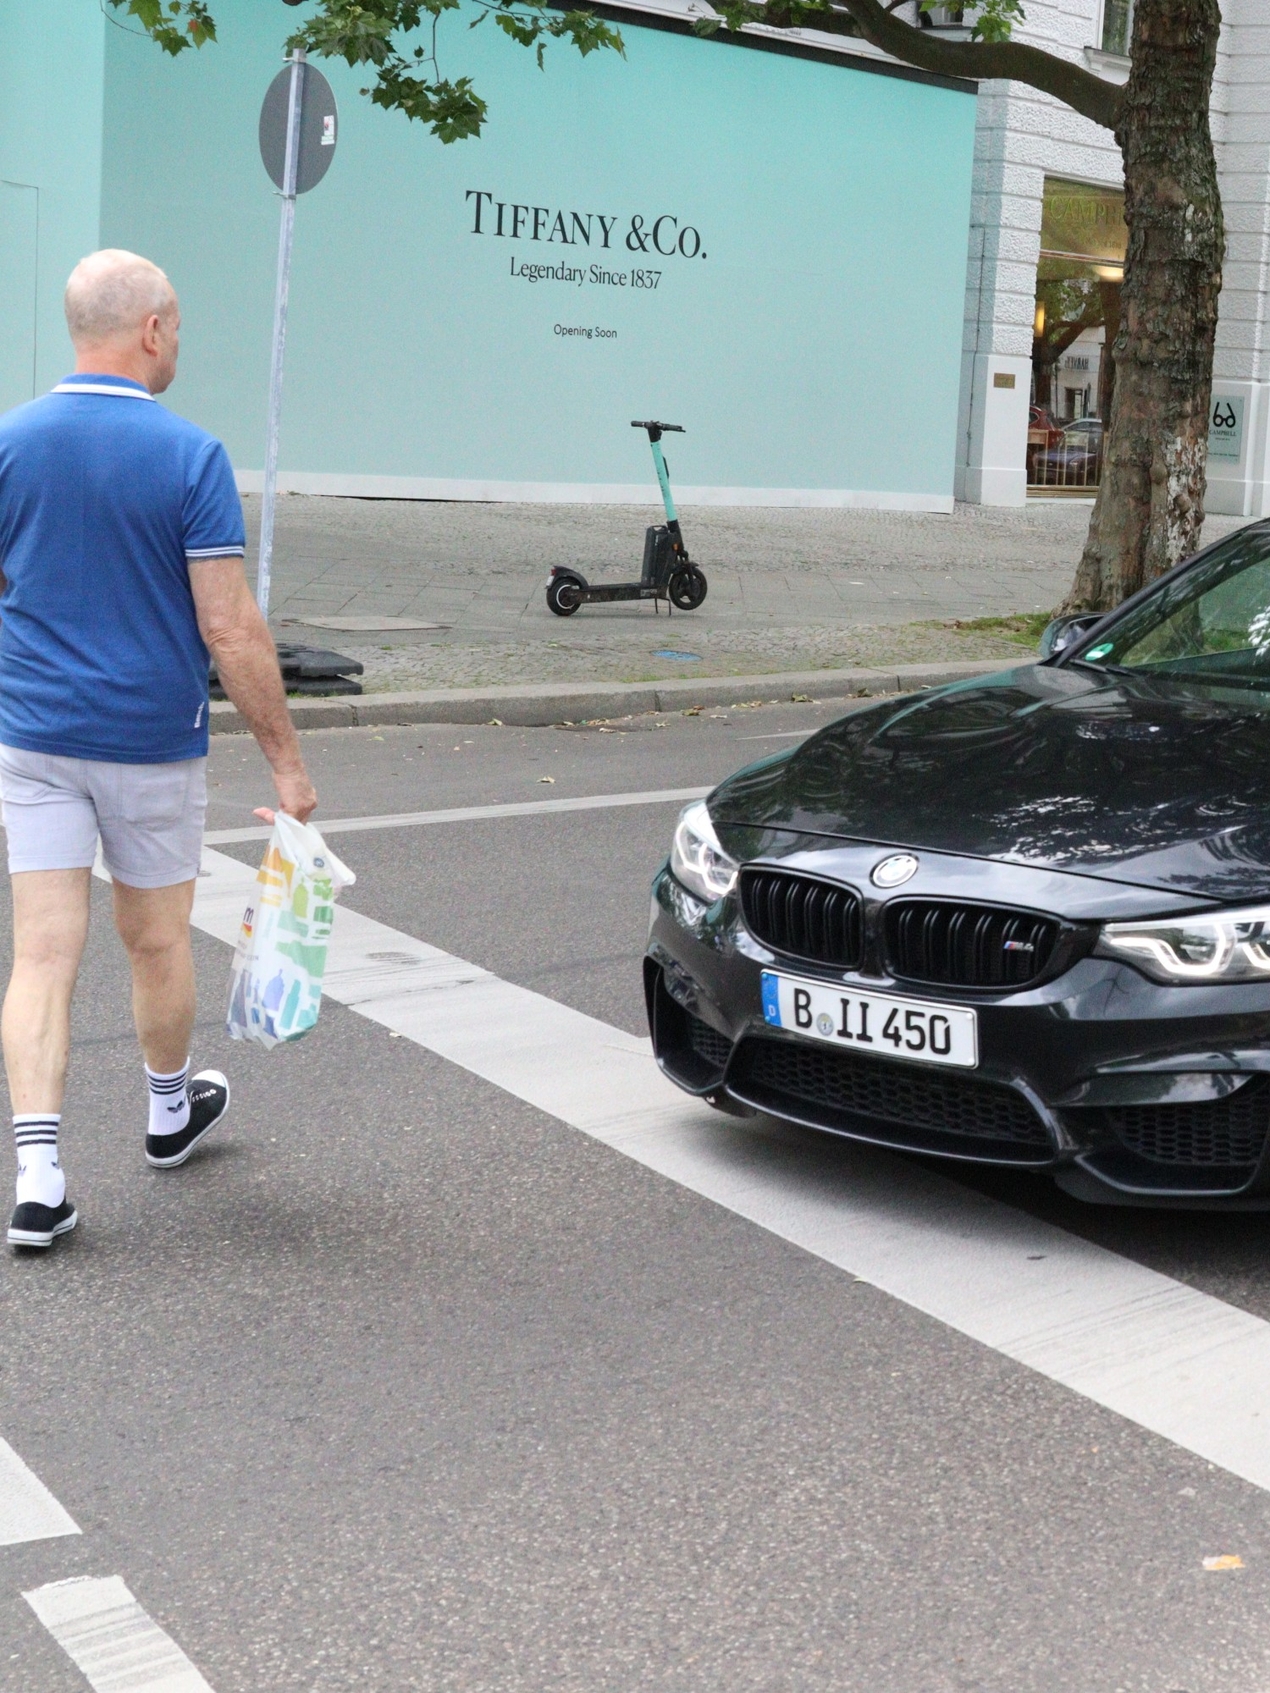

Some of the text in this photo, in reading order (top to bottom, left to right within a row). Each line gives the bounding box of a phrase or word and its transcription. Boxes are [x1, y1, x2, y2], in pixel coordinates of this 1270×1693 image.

[510, 256, 662, 290] Legendary Since 1837
[553, 323, 618, 339] Opening Soon
[768, 988, 951, 1055] D B II 450
